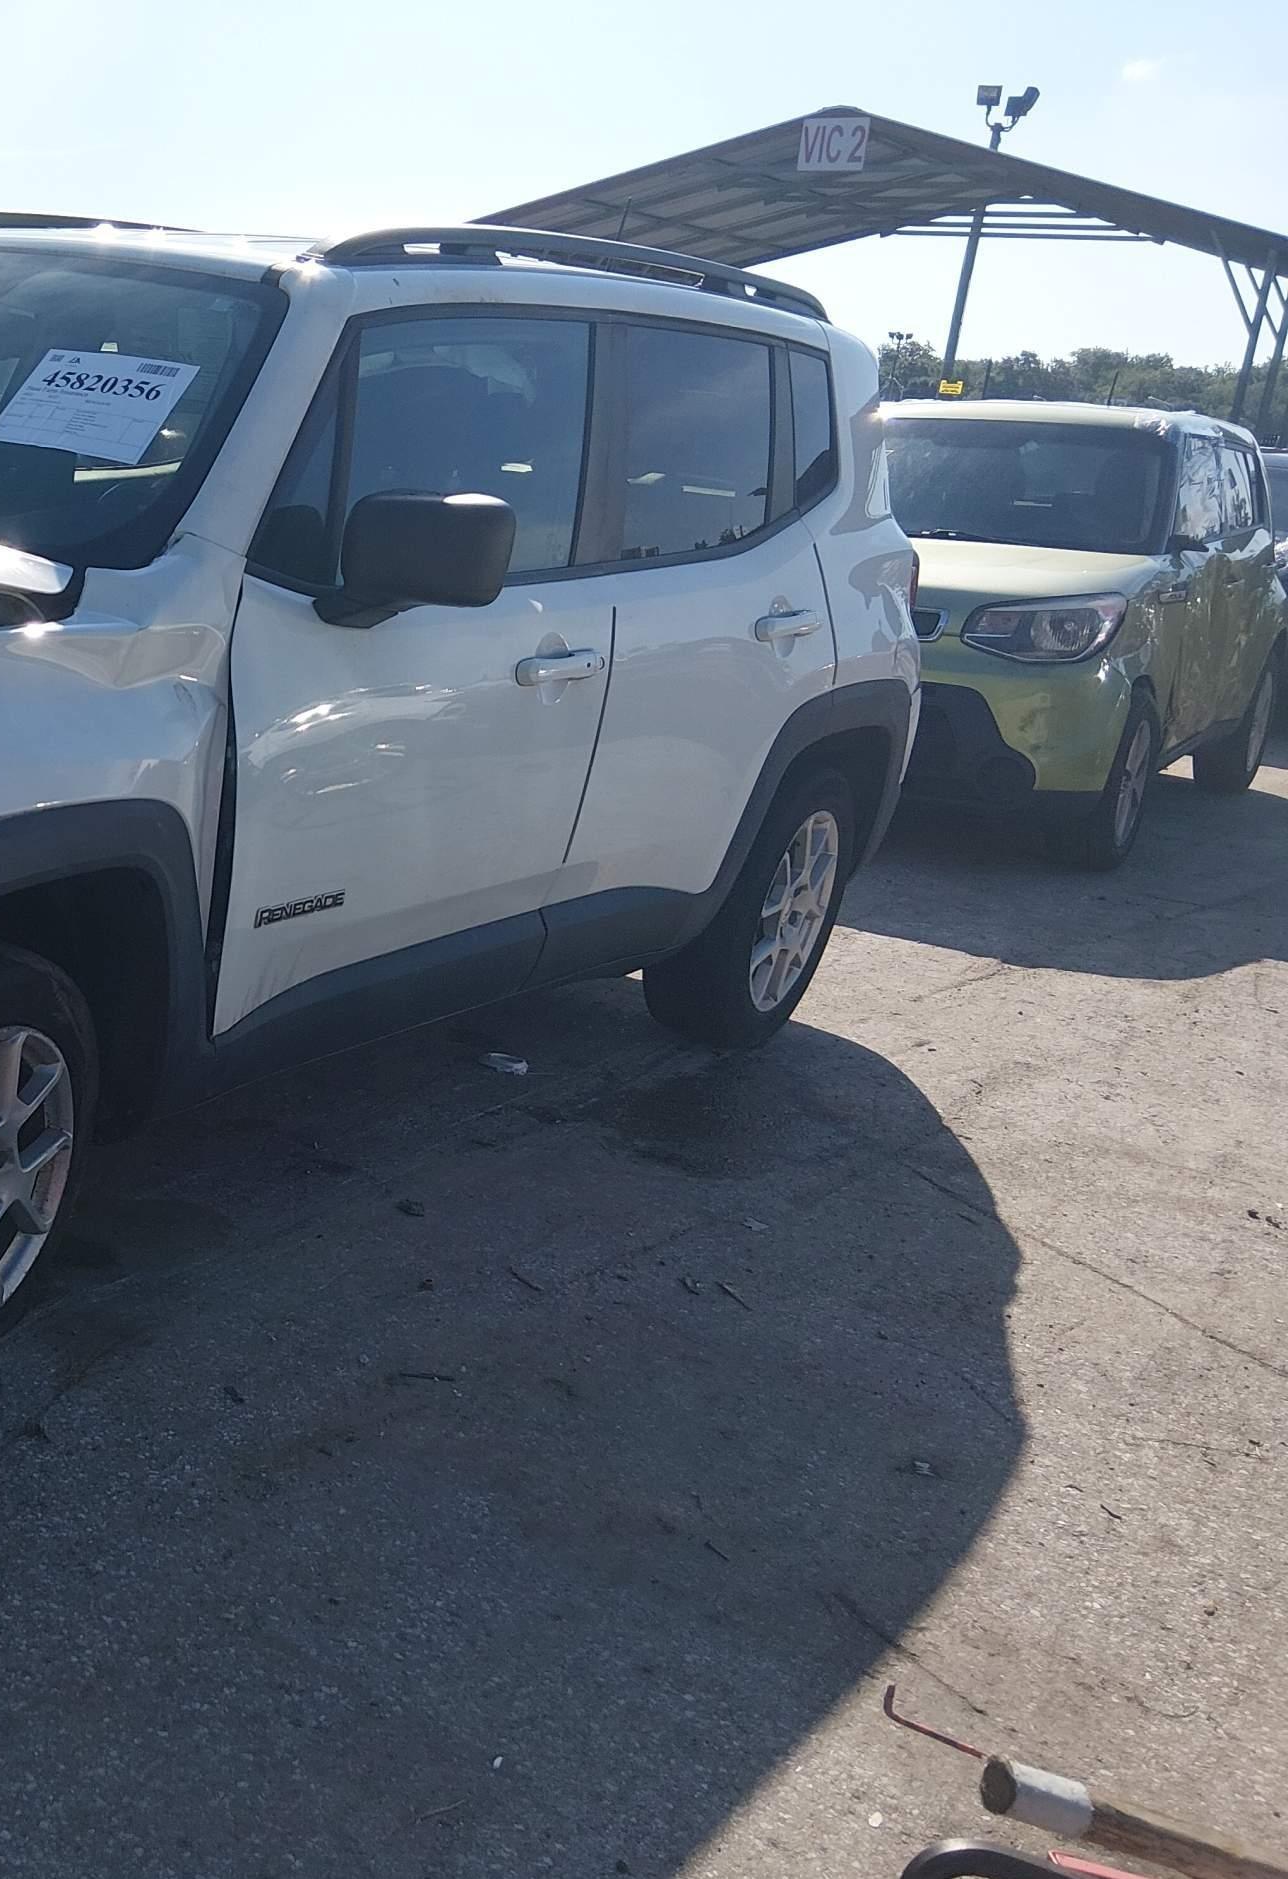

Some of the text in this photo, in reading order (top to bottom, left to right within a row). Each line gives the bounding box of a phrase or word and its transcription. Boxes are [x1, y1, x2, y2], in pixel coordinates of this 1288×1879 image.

[804, 125, 866, 163] VIC 2
[42, 370, 165, 400] 45820356
[254, 889, 345, 928] RENEGADE
